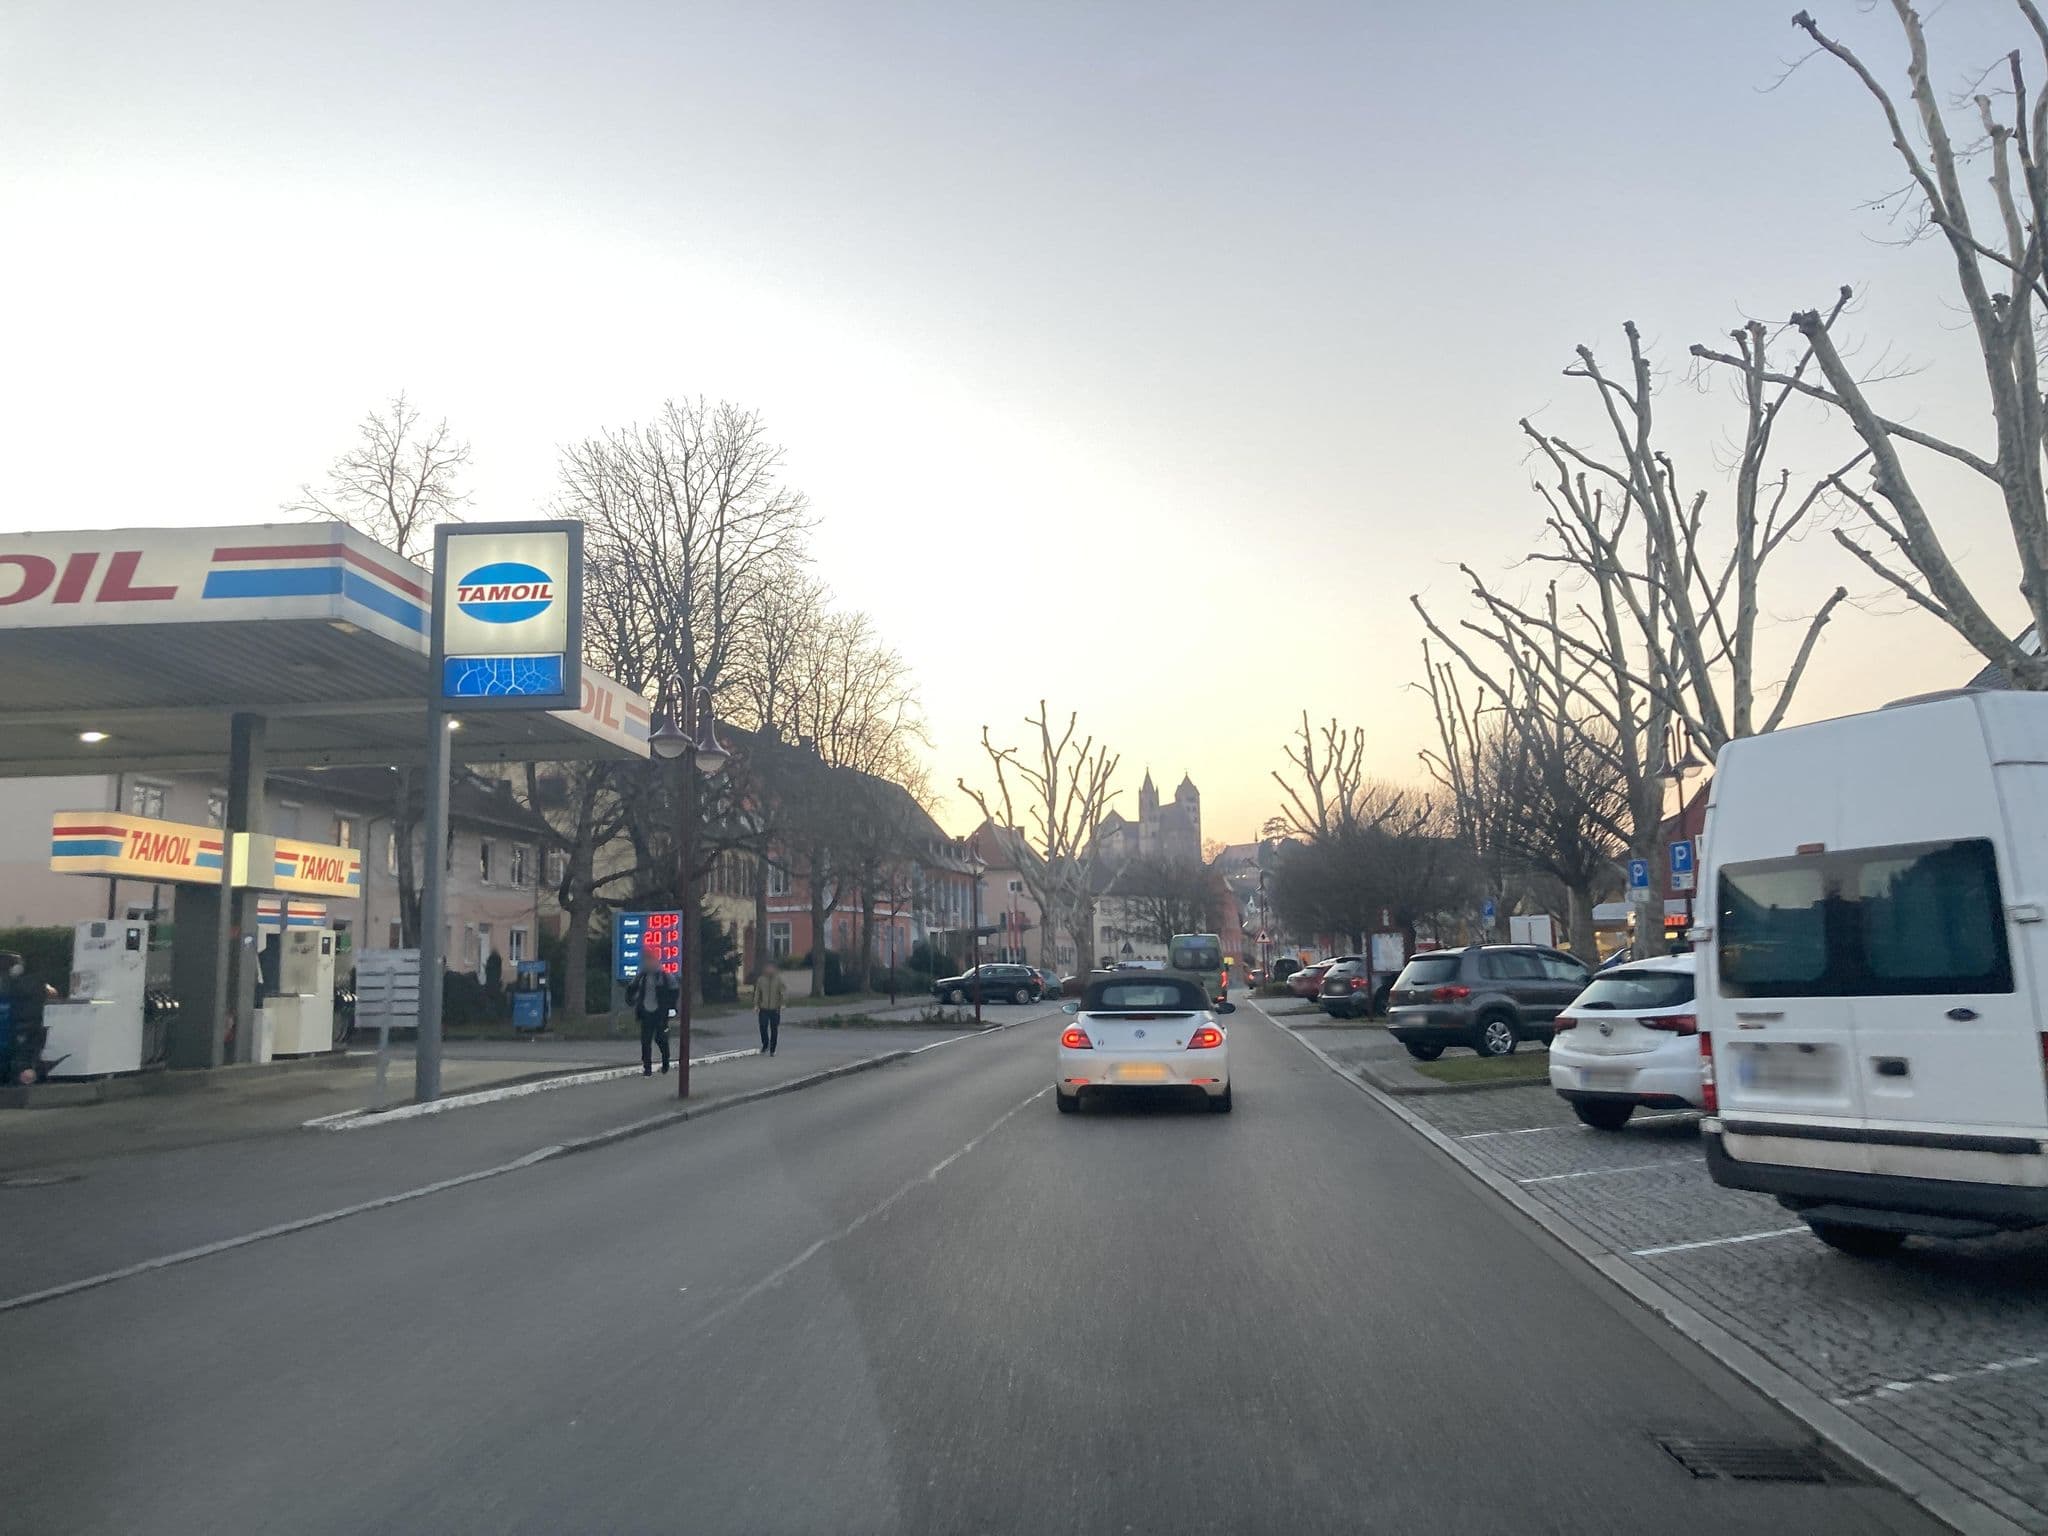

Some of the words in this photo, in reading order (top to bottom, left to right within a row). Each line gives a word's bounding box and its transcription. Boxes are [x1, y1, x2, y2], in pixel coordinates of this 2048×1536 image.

[457, 584, 554, 602] TAMOIL
[128, 830, 191, 865] TAMOIL
[300, 854, 345, 883] TAMOIL
